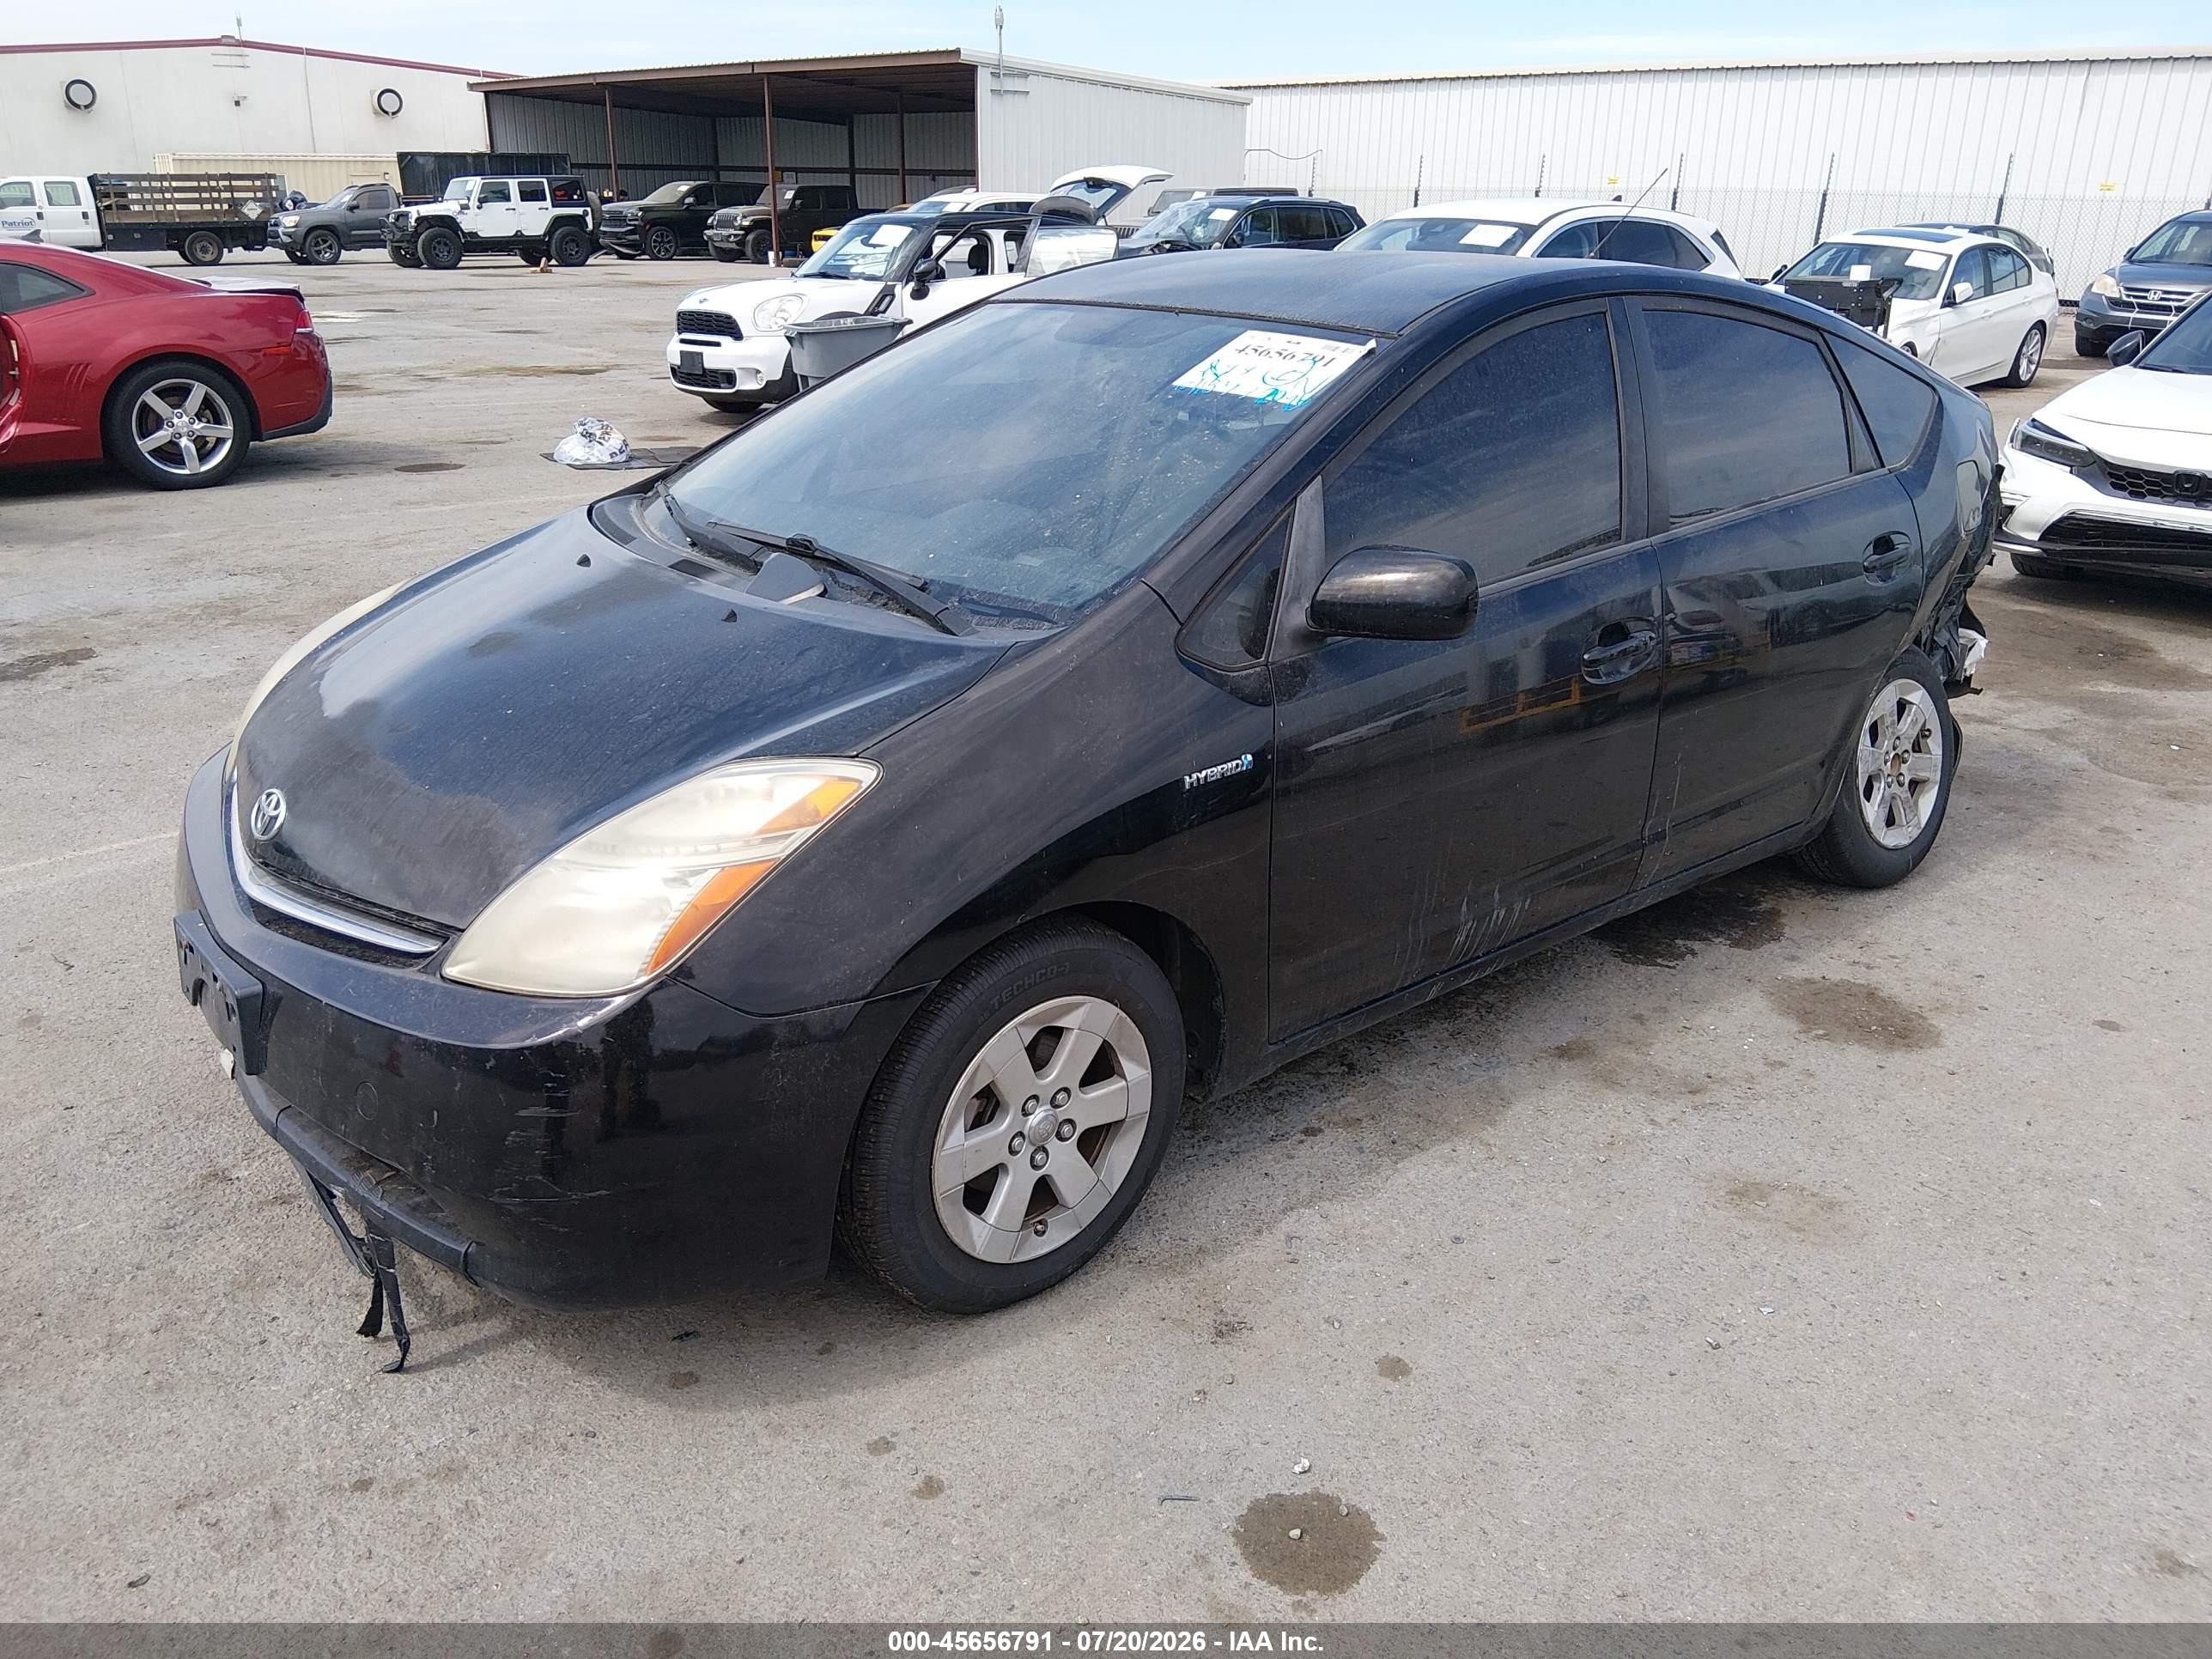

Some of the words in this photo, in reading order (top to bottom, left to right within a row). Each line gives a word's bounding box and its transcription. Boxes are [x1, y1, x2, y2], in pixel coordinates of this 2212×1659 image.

[2, 219, 34, 228] Patriot
[1234, 343, 1337, 368] 45656791
[1183, 758, 1243, 790] HYBRID
